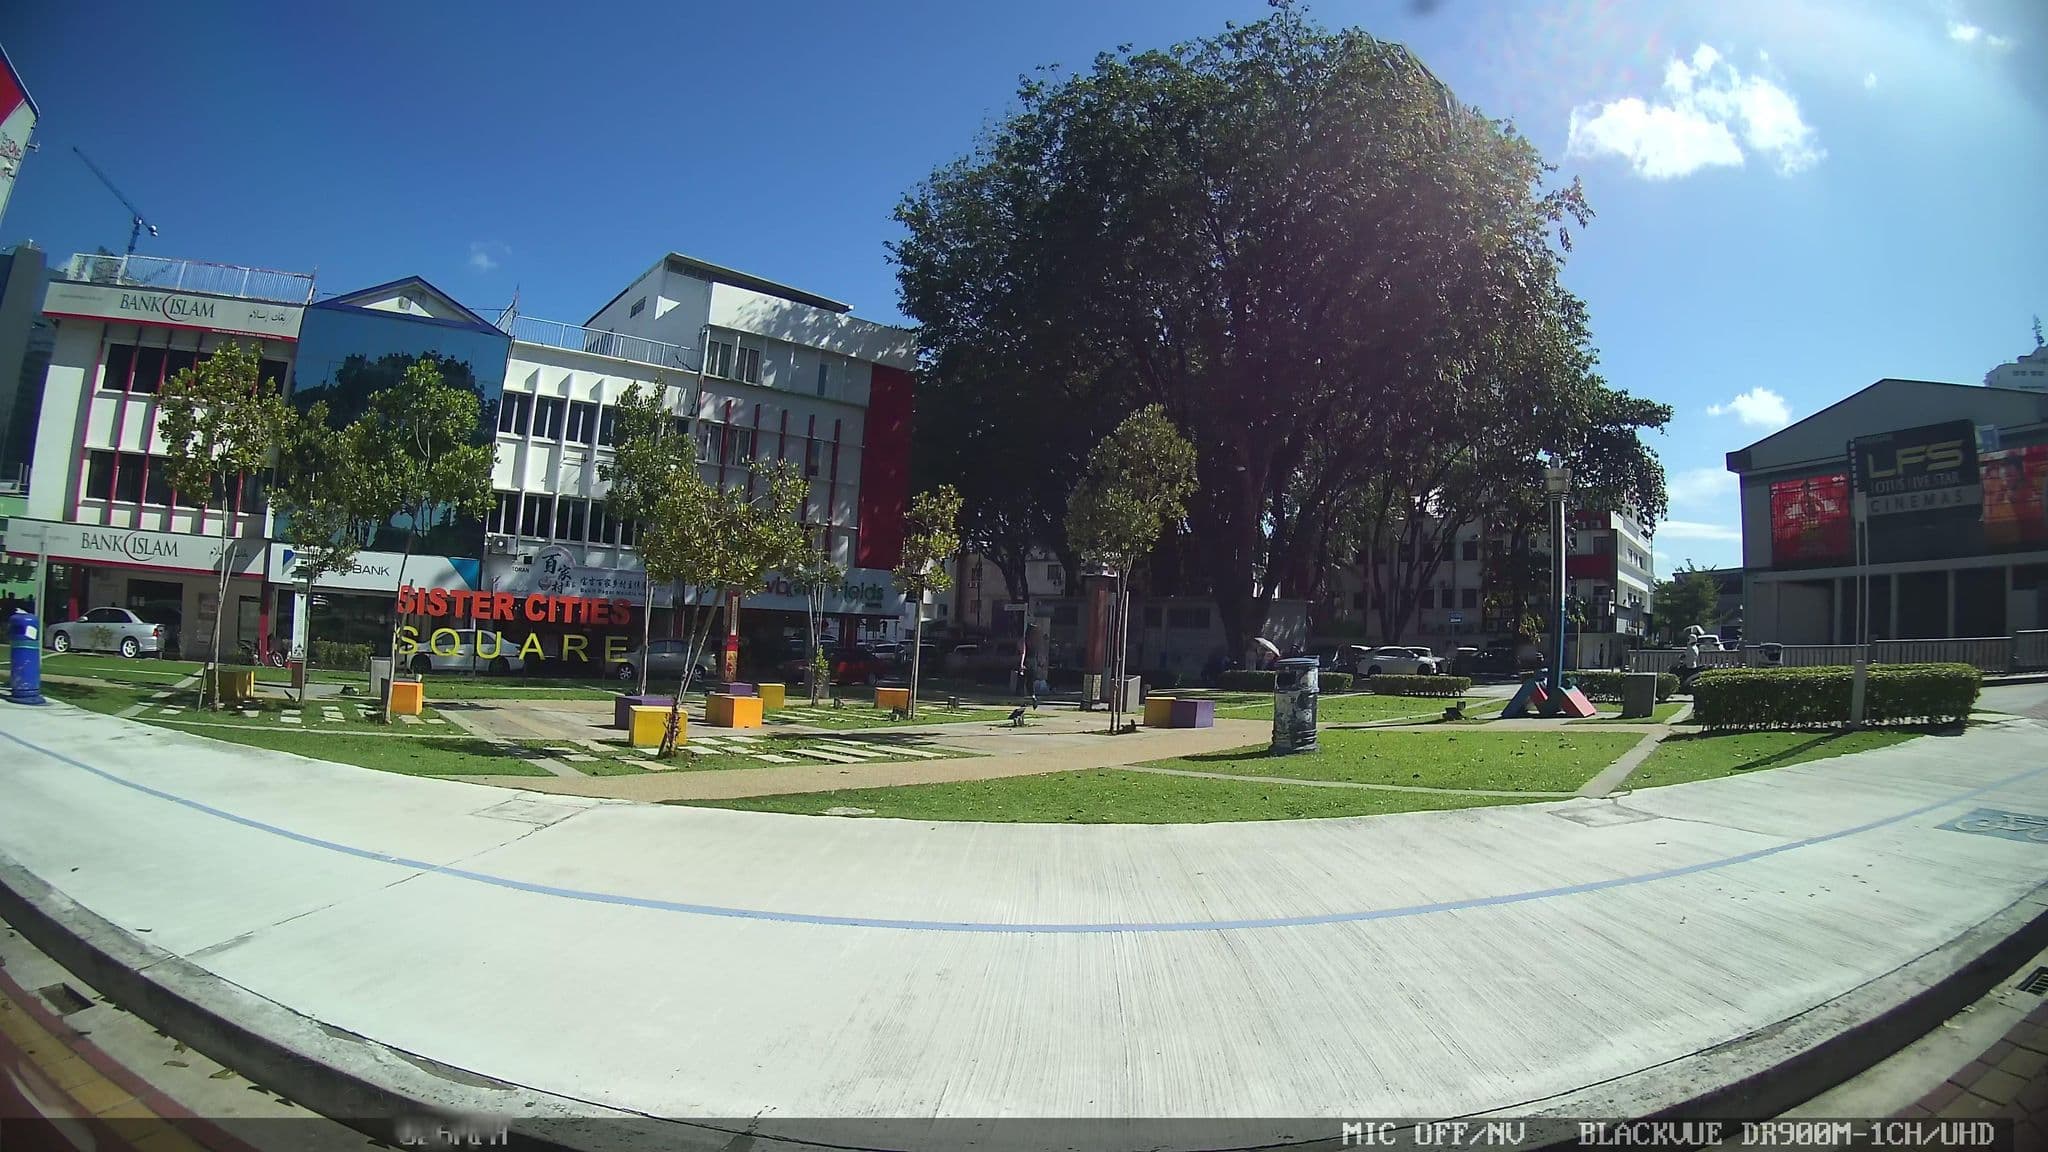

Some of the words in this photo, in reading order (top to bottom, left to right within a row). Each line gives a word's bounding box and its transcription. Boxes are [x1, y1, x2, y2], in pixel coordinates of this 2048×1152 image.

[120, 293, 162, 312] BANK
[169, 300, 215, 318] ISLAM
[1867, 439, 1965, 479] LFS
[1869, 488, 1965, 513] CINEMAS
[81, 531, 125, 551] BANK
[132, 537, 178, 557] ISLAM
[396, 585, 516, 620] SISTER
[524, 596, 632, 625] CITIES
[395, 625, 632, 664] SQUARE
